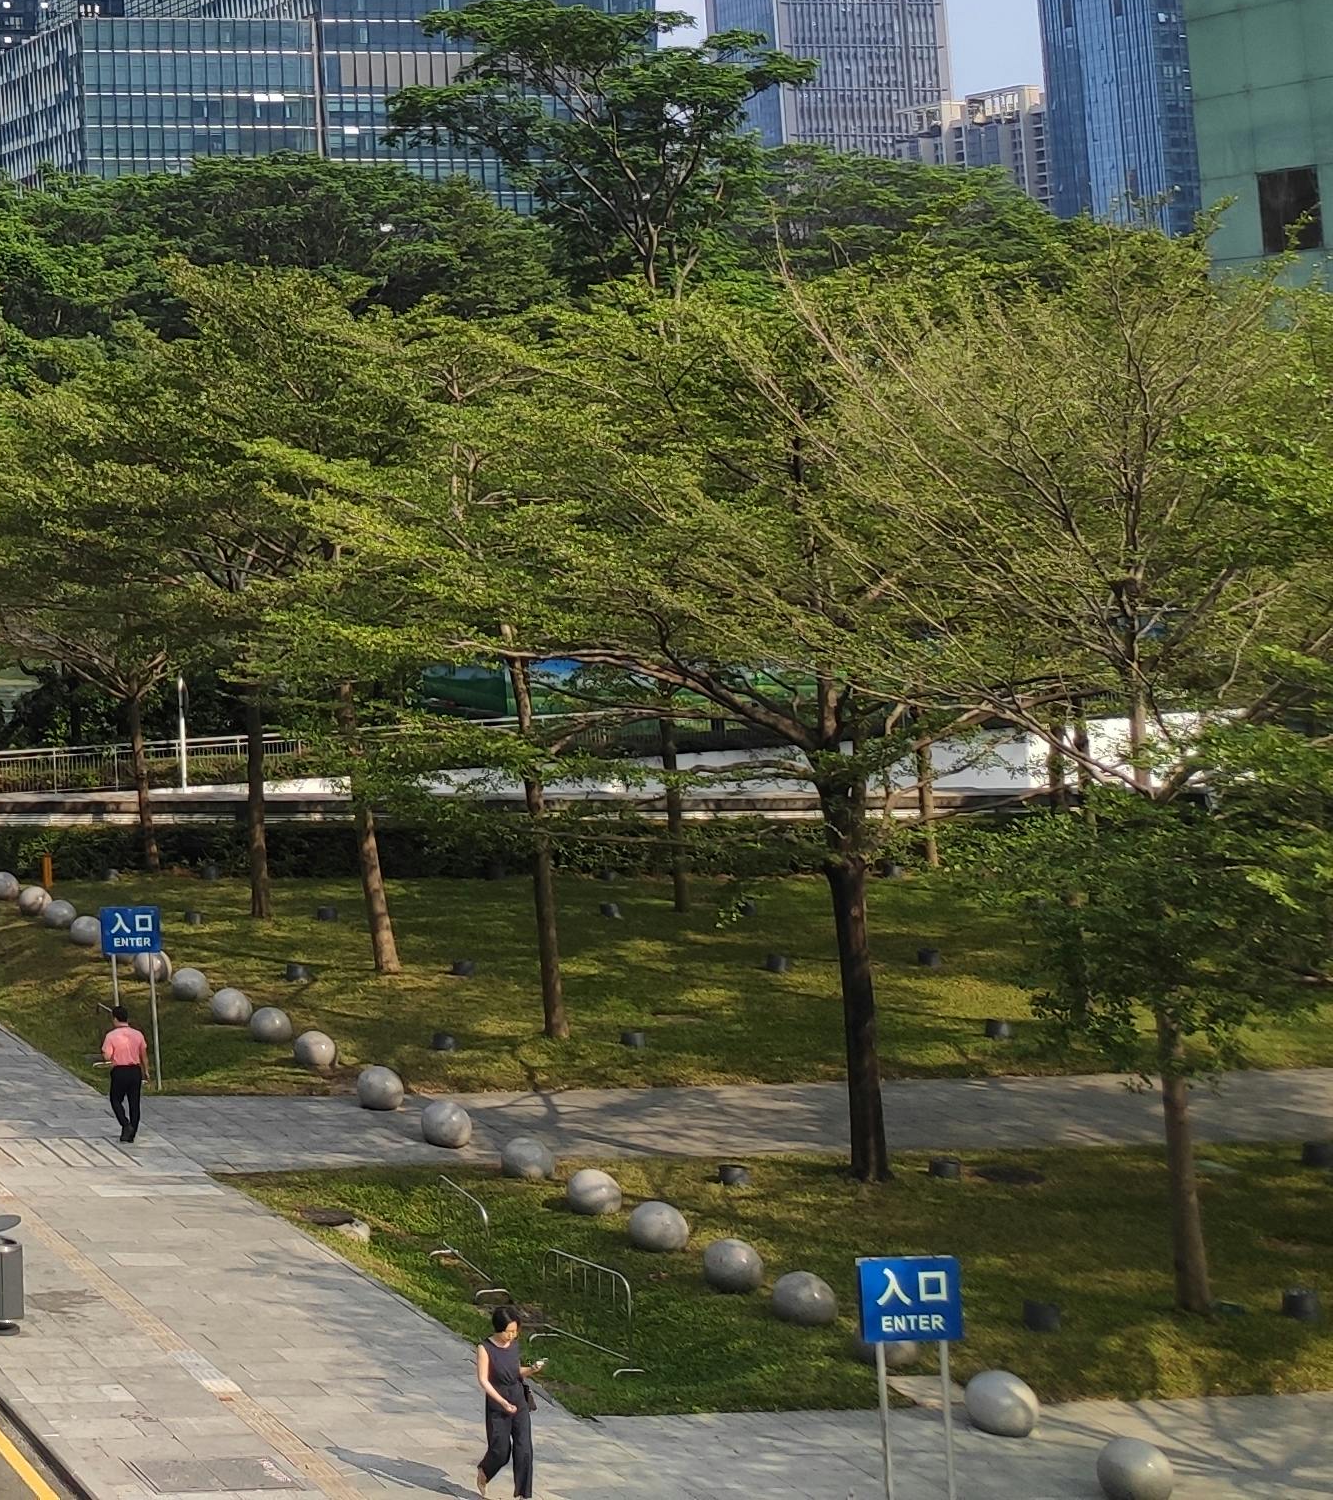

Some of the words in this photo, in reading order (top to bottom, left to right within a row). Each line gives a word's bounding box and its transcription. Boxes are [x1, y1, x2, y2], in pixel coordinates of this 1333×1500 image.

[110, 912, 153, 934] 入口
[113, 937, 151, 947] ENTER
[876, 1267, 948, 1306] 入口
[881, 1315, 946, 1332] ENTER
